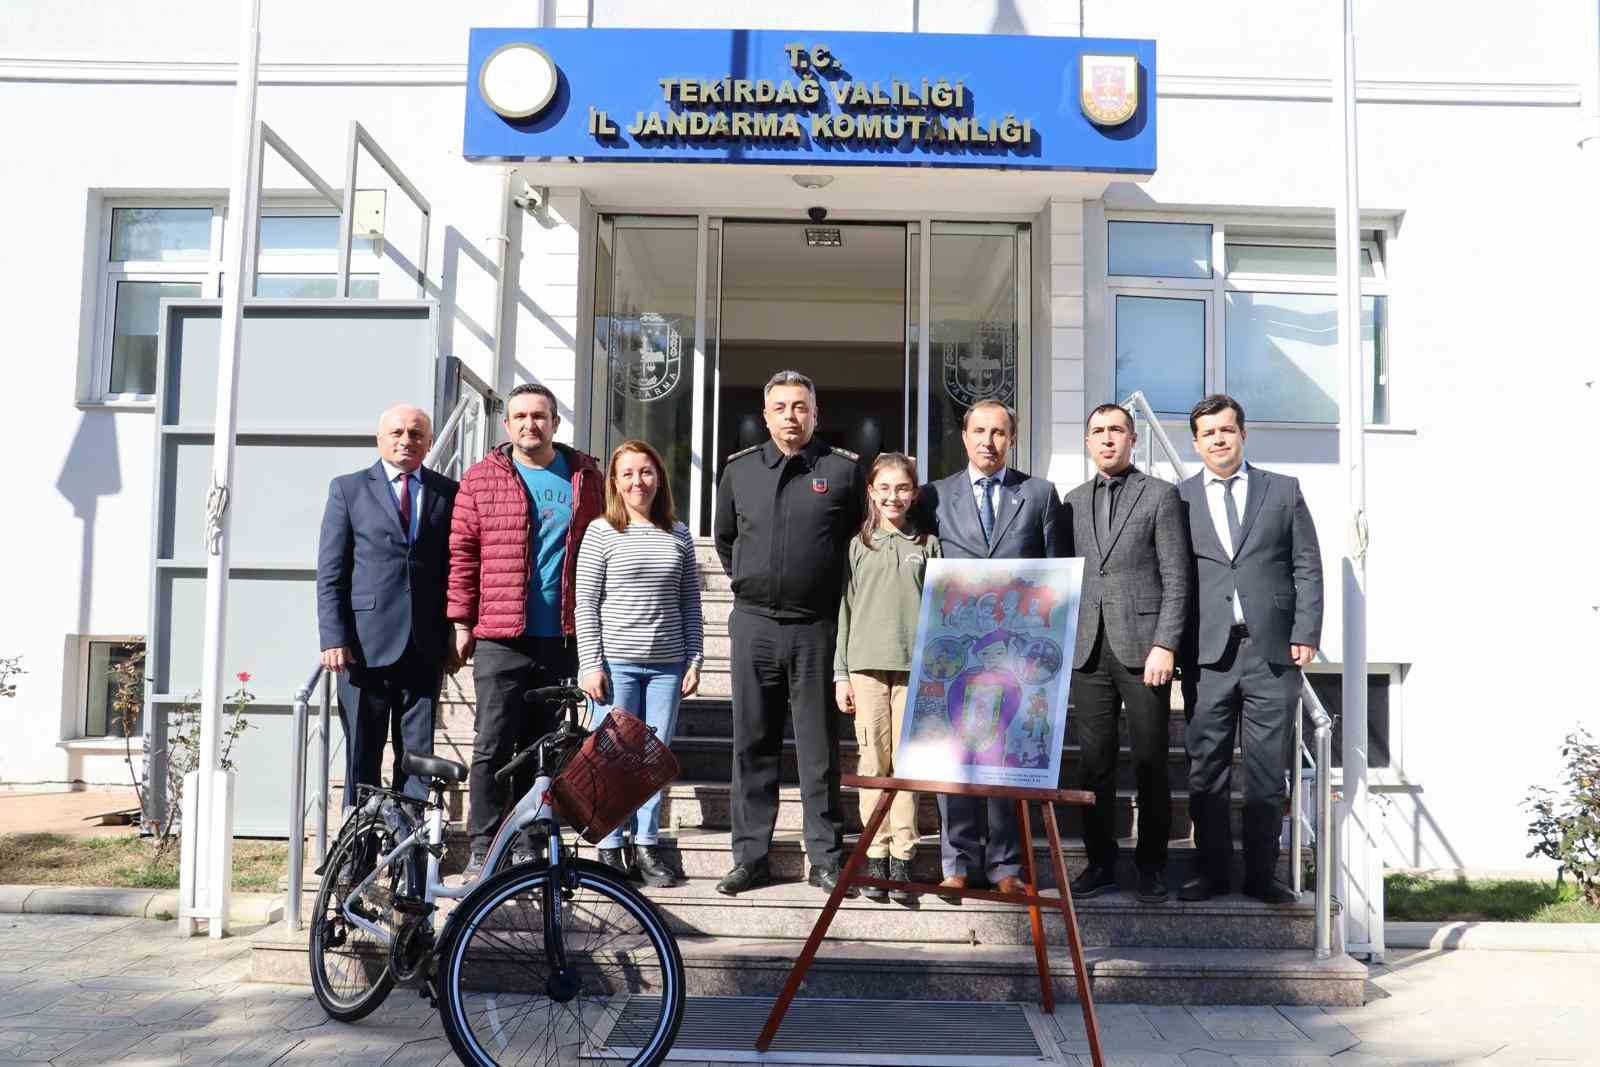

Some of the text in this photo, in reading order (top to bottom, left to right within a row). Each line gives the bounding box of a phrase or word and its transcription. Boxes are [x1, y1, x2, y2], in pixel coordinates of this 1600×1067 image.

[785, 43, 842, 69] T.C.
[659, 73, 964, 108] TEKİRDAĞ VALİLİĞİ
[588, 105, 1032, 144] İL JANDARMA KOMUTANLIĞI
